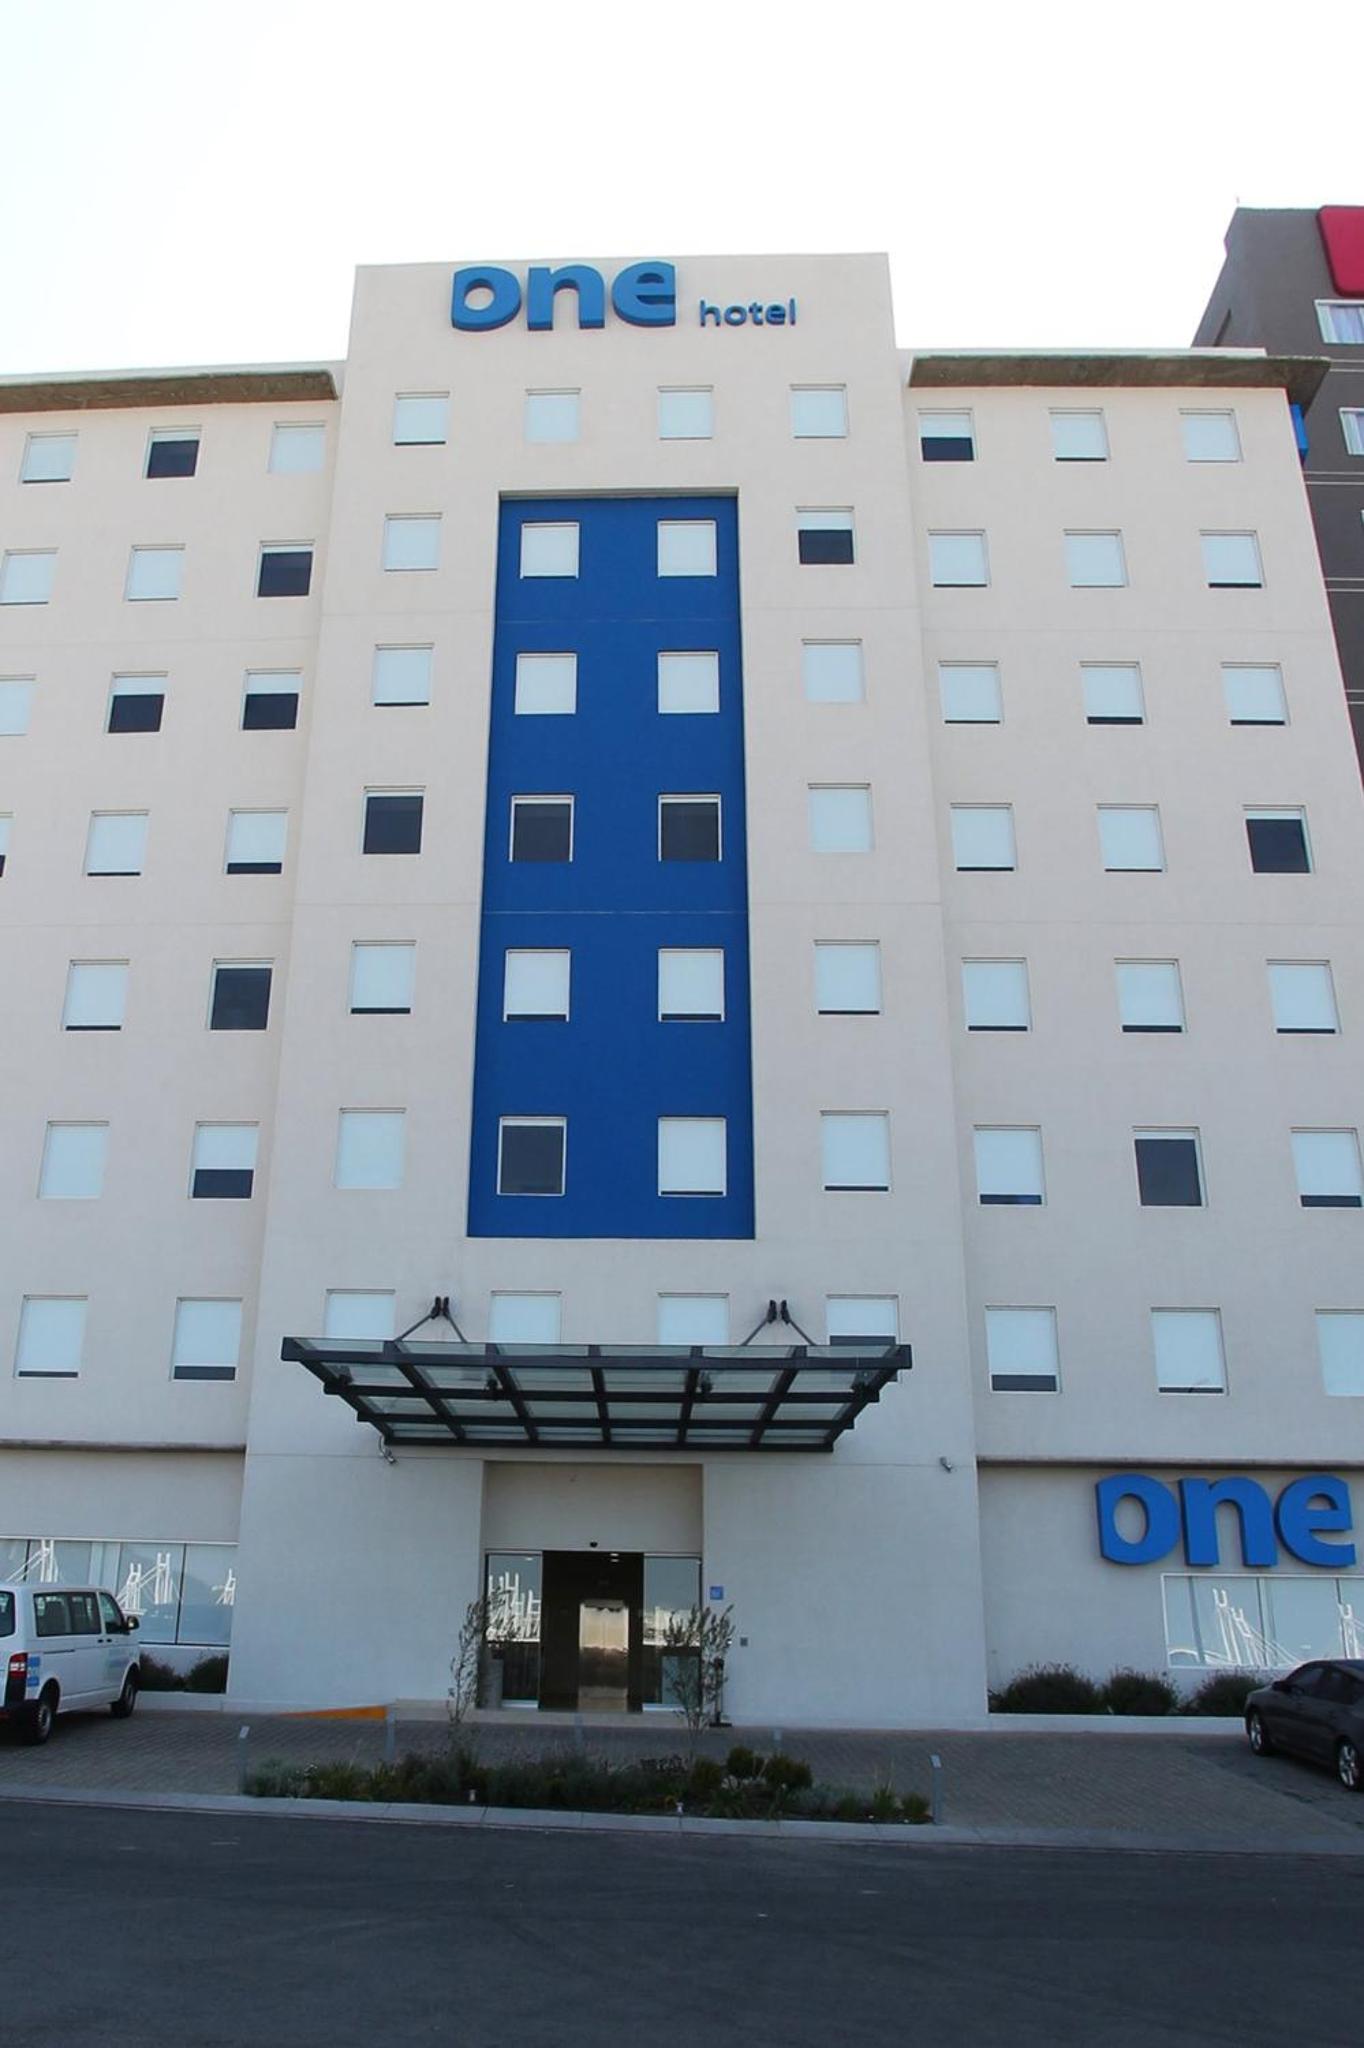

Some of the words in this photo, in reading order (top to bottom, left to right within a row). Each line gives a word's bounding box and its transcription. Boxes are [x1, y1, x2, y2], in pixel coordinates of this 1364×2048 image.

[453, 261, 676, 330] one
[700, 298, 796, 326] hotel
[1096, 1473, 1356, 1567] one
